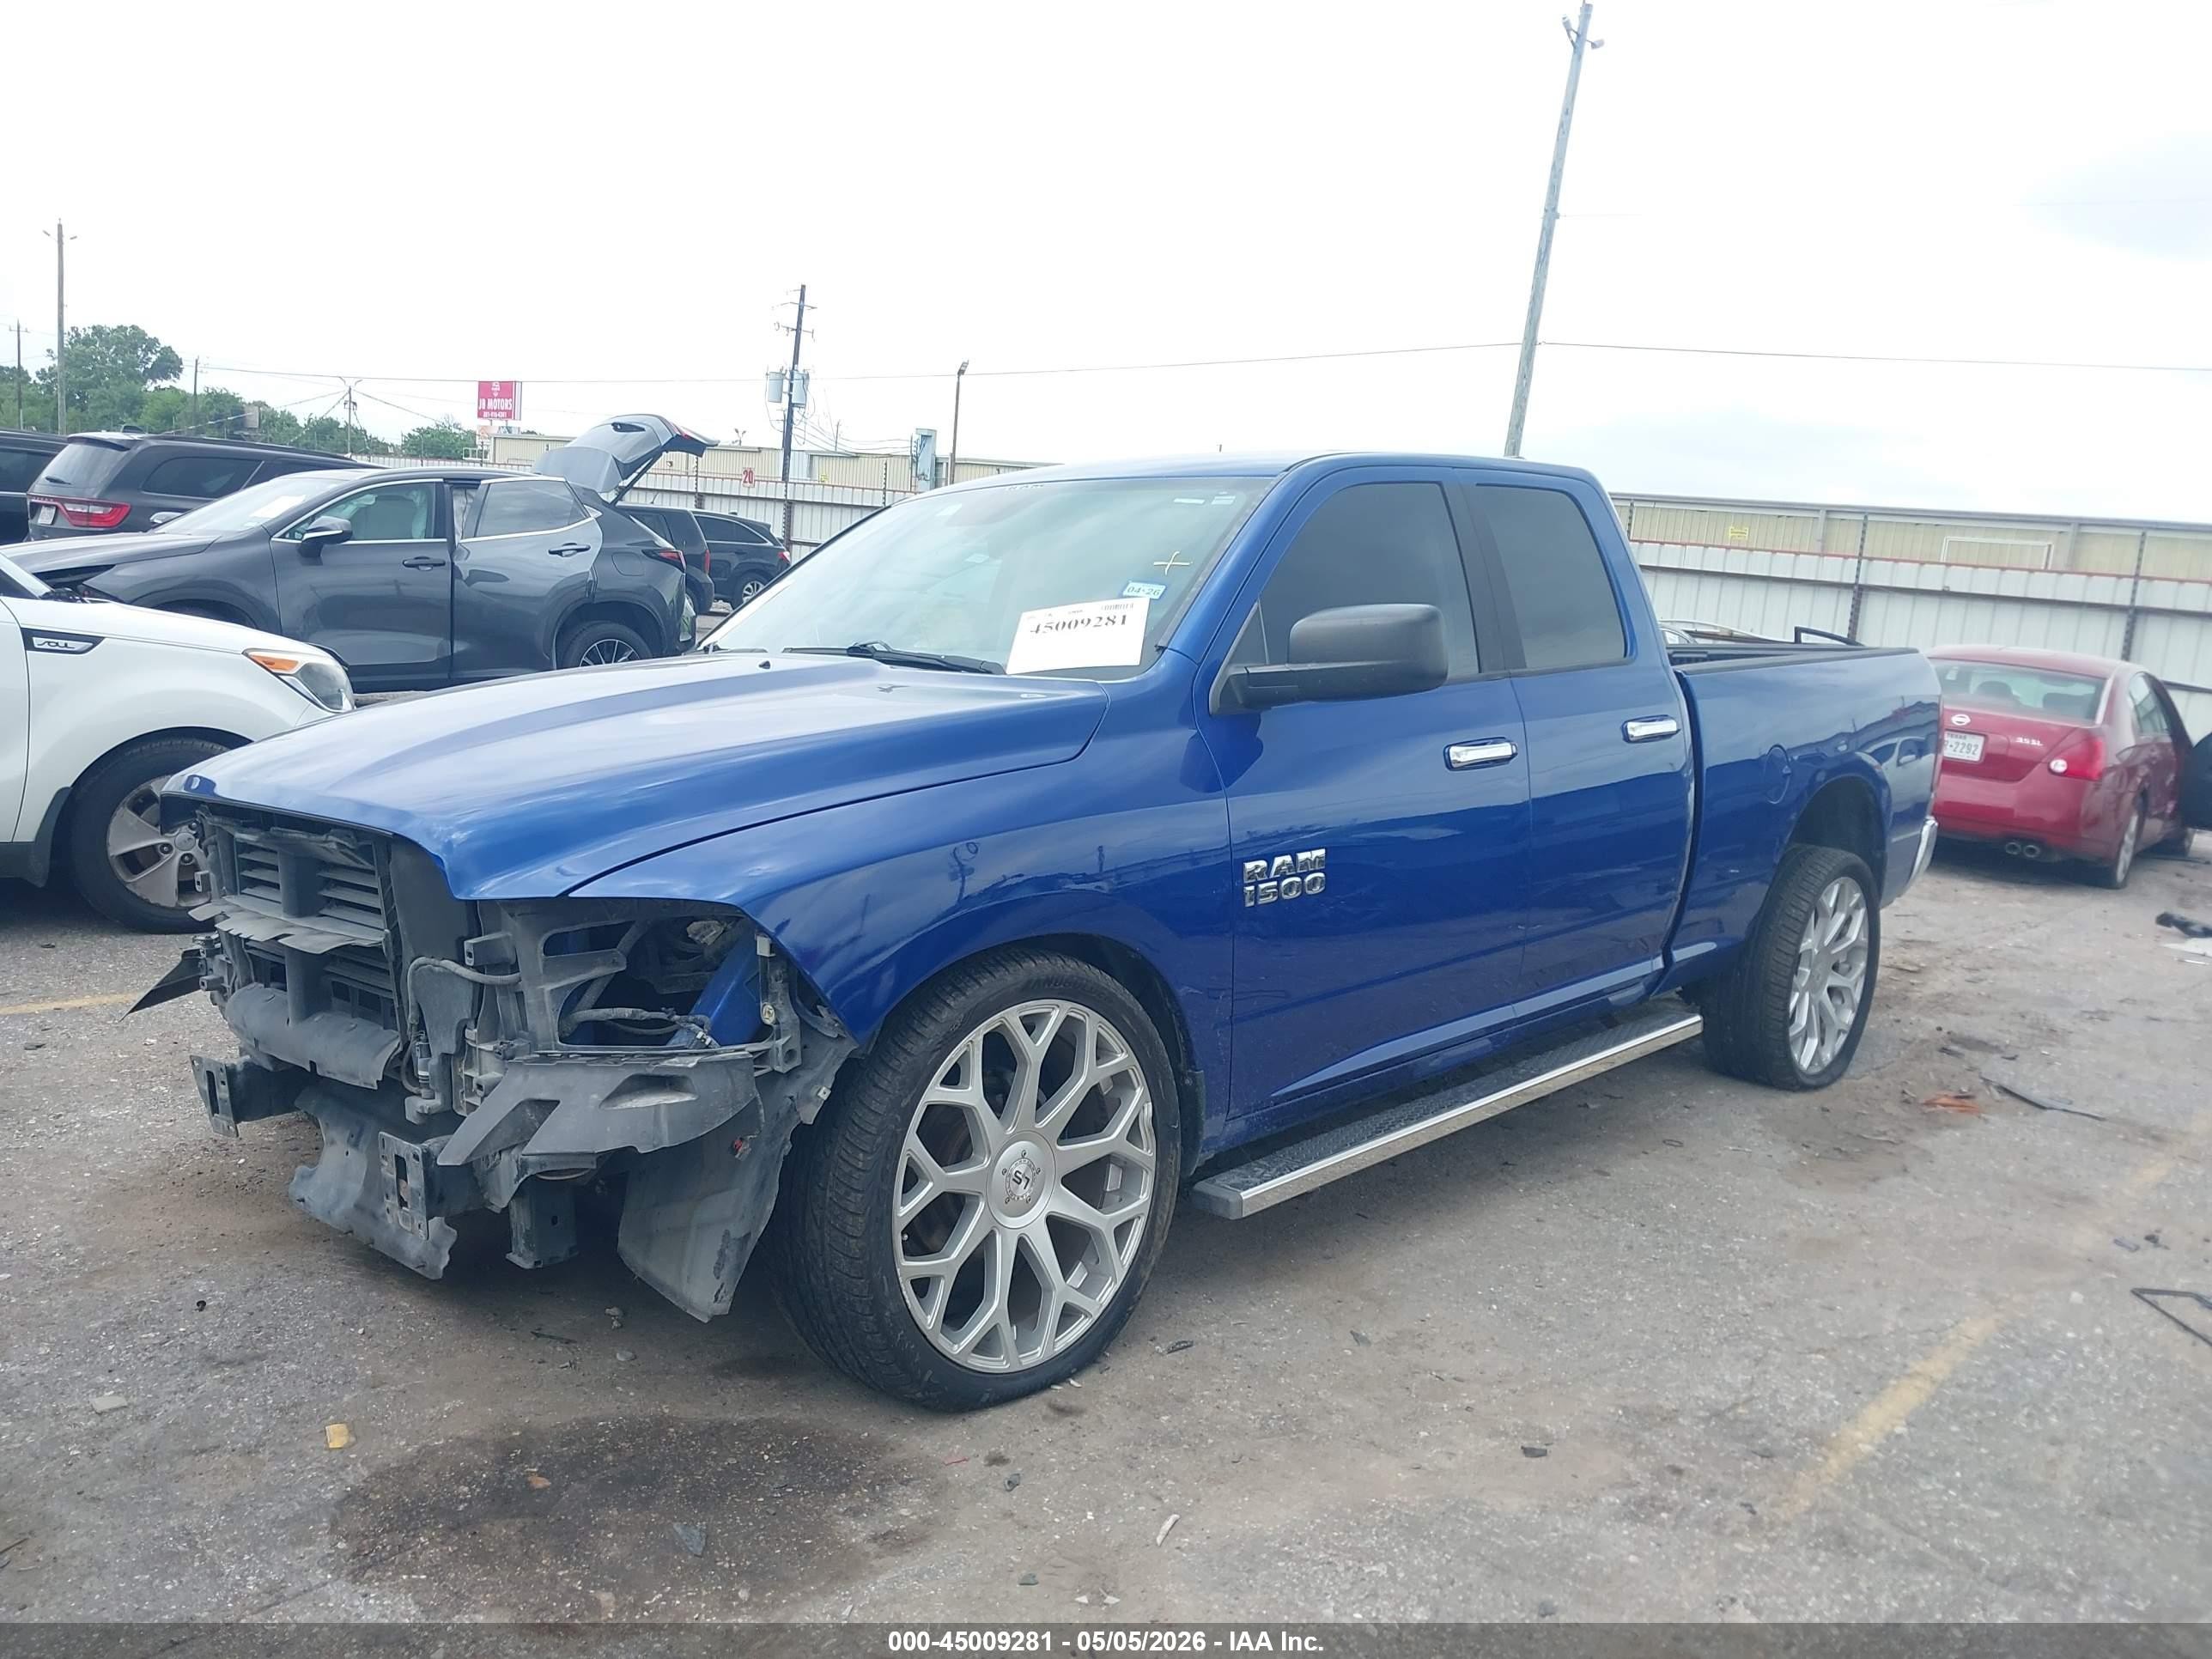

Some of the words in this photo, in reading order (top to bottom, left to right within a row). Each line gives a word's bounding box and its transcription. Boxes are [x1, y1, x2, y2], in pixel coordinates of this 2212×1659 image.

[487, 398, 513, 410] MOTORS
[742, 470, 754, 483] 20
[1030, 614, 1127, 634] 45009281
[1243, 848, 1326, 884] RAM
[1243, 872, 1326, 908] 1500
